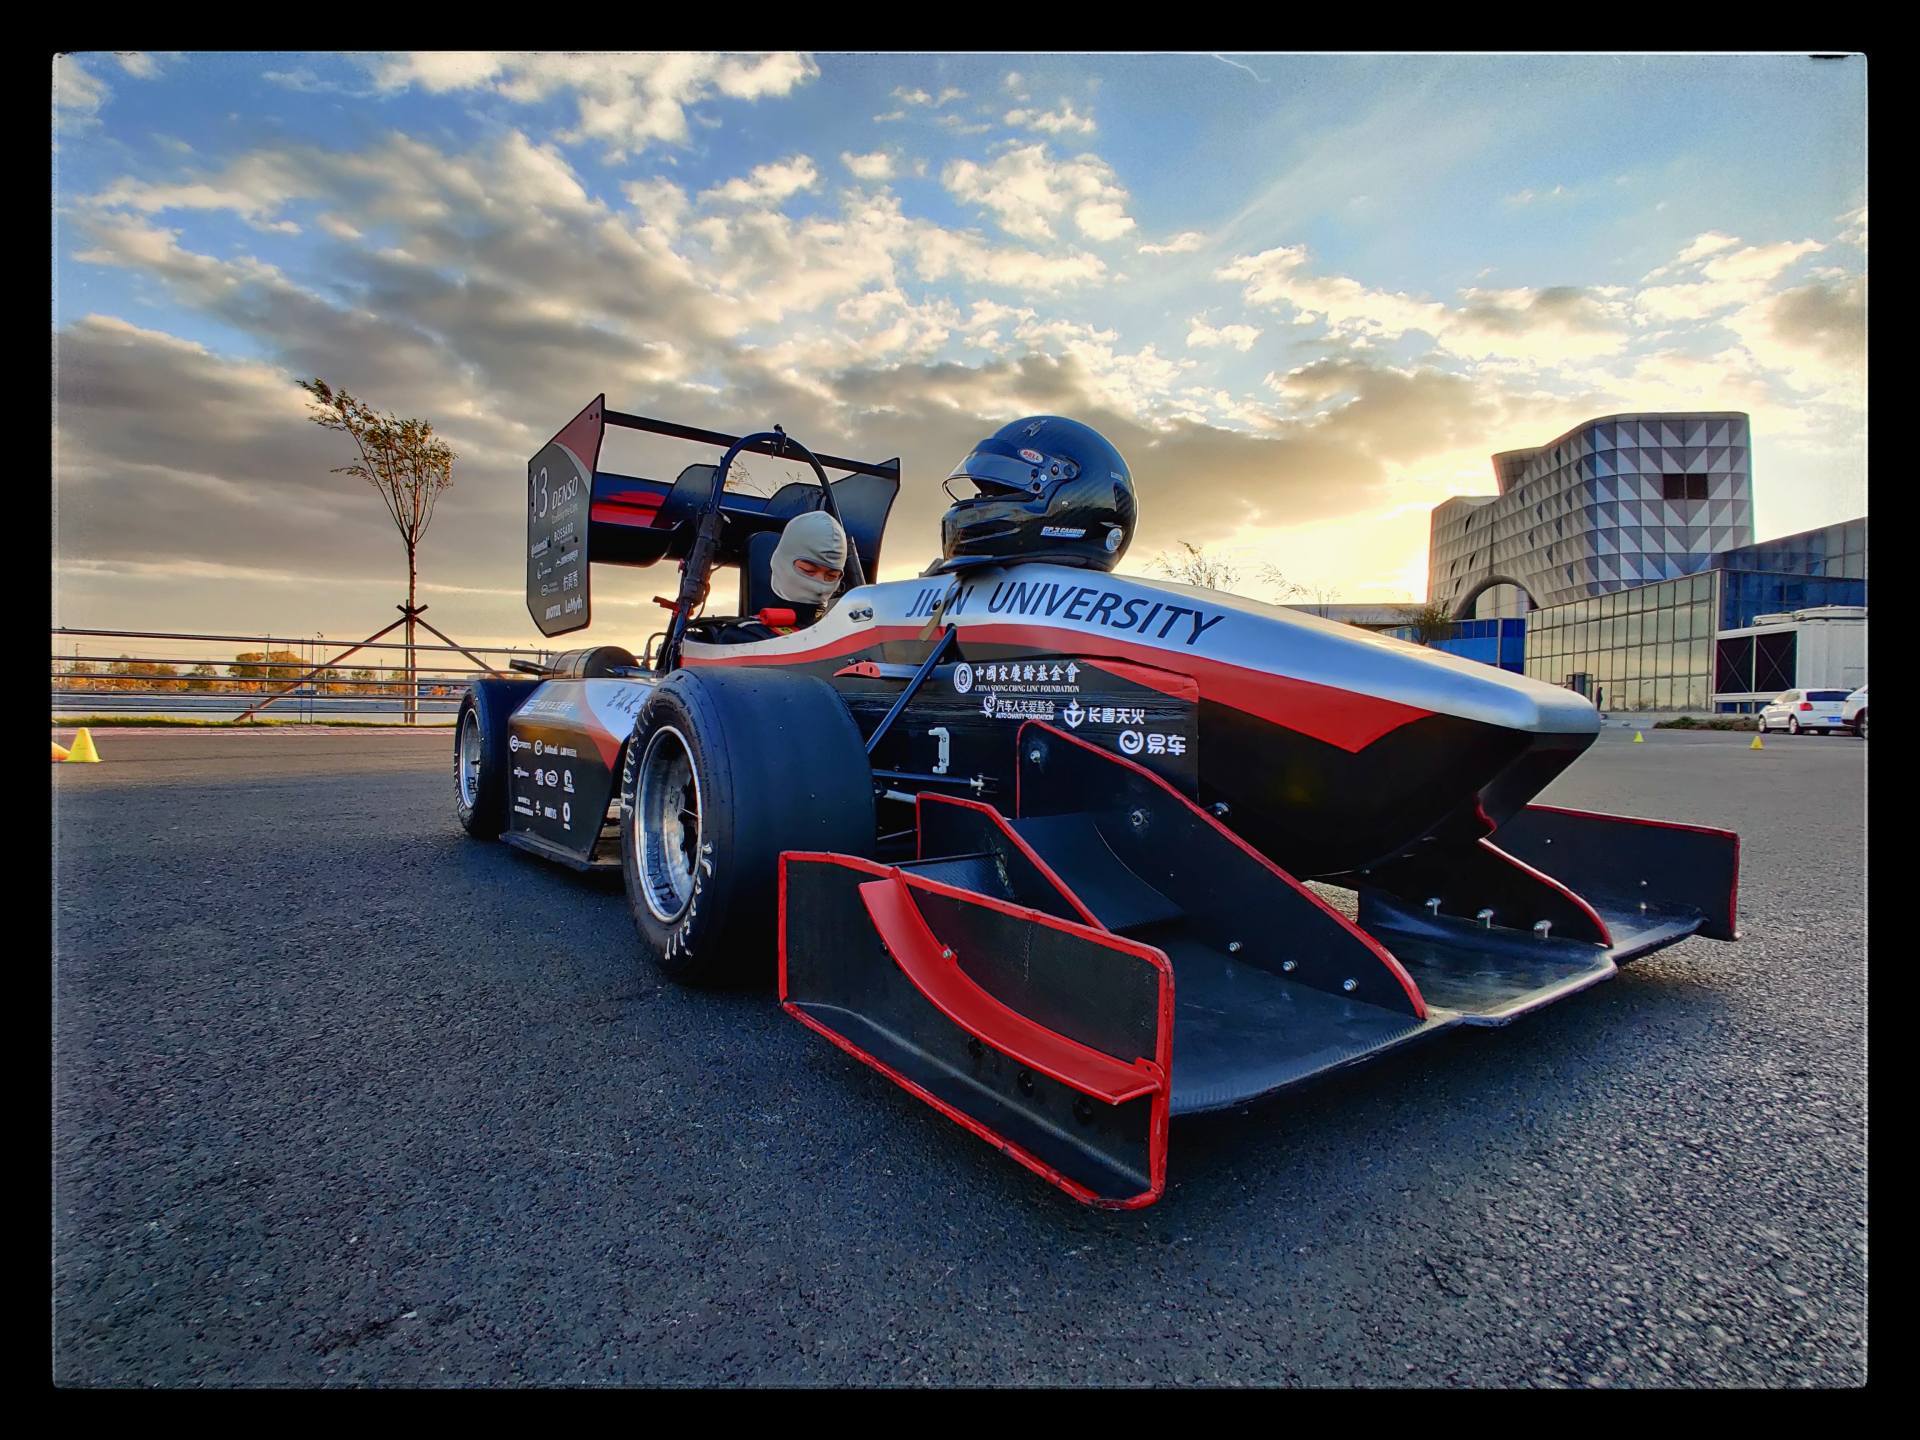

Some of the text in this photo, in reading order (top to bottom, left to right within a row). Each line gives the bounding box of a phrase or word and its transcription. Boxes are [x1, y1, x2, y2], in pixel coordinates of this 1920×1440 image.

[552, 476, 578, 510] DENSO
[905, 581, 1224, 645] JILN UNIVERSITY
[1040, 684, 1080, 693] FOUNDATION
[997, 700, 1055, 714] 汽车人关爱基金
[1147, 733, 1186, 756] 易车
